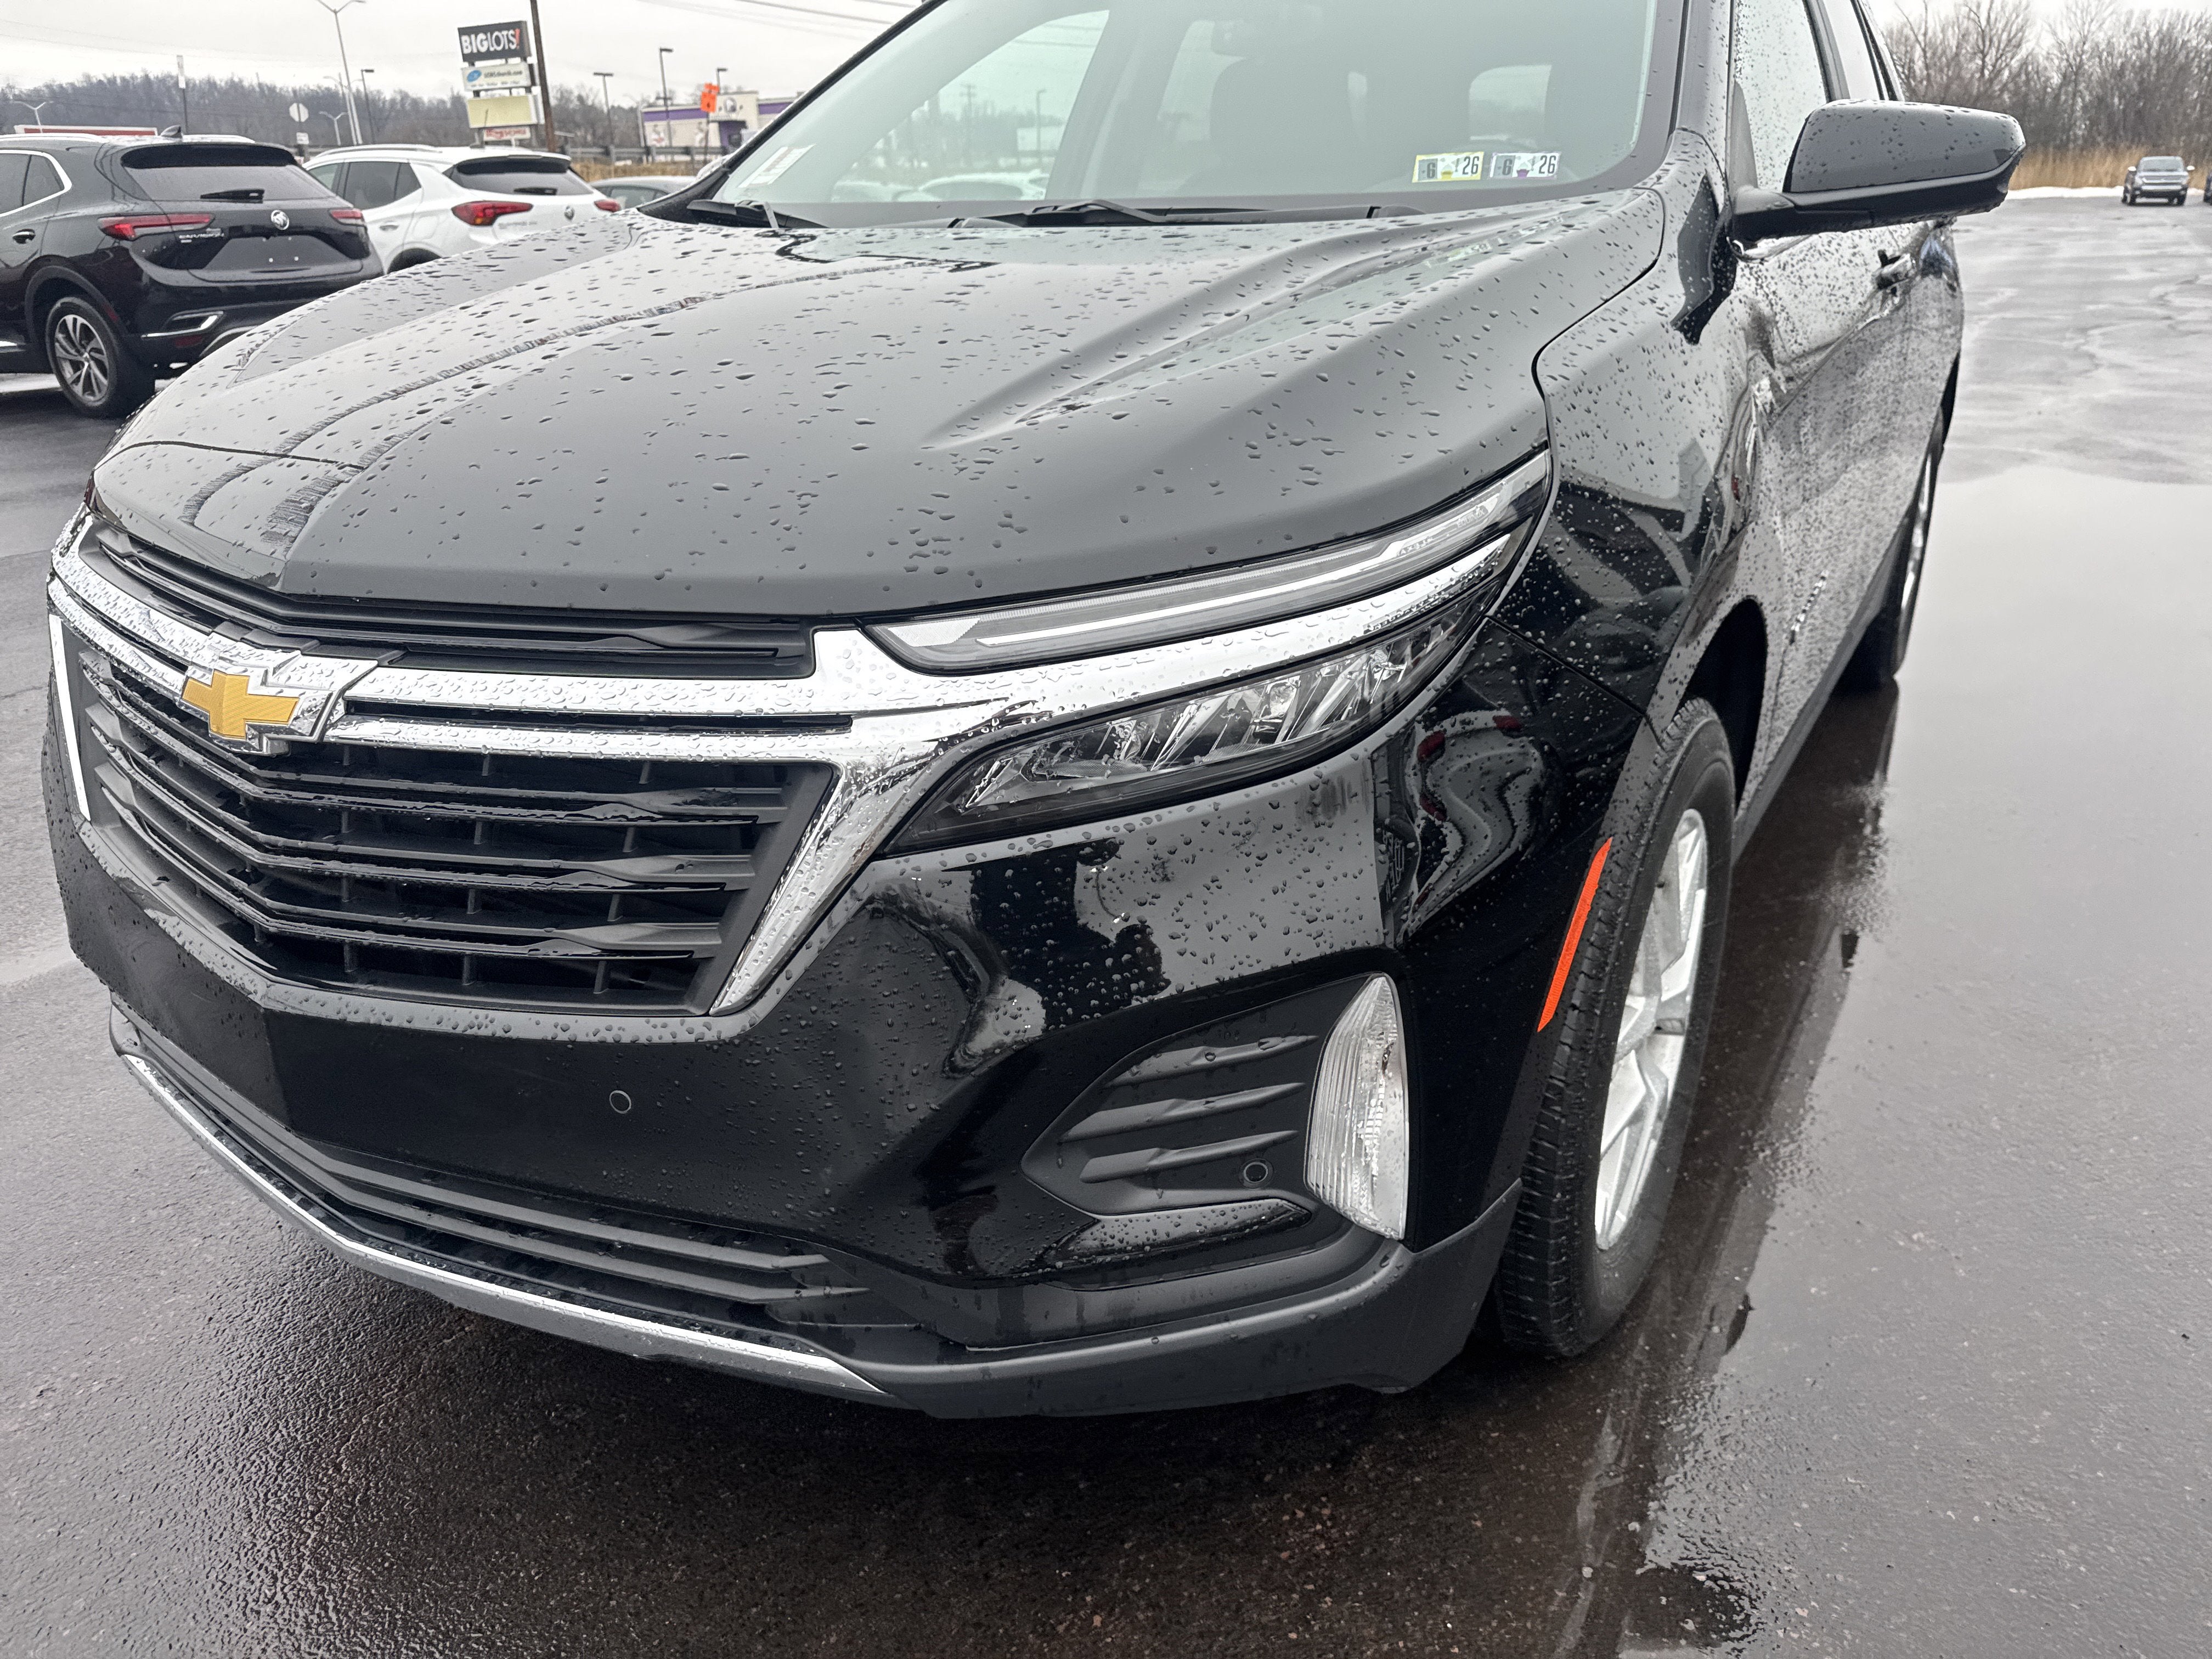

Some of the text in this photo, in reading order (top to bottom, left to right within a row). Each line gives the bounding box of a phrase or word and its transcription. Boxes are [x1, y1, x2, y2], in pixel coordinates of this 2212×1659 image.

[1426, 156, 1480, 179] 6 26
[1502, 155, 1556, 176] 6 26
